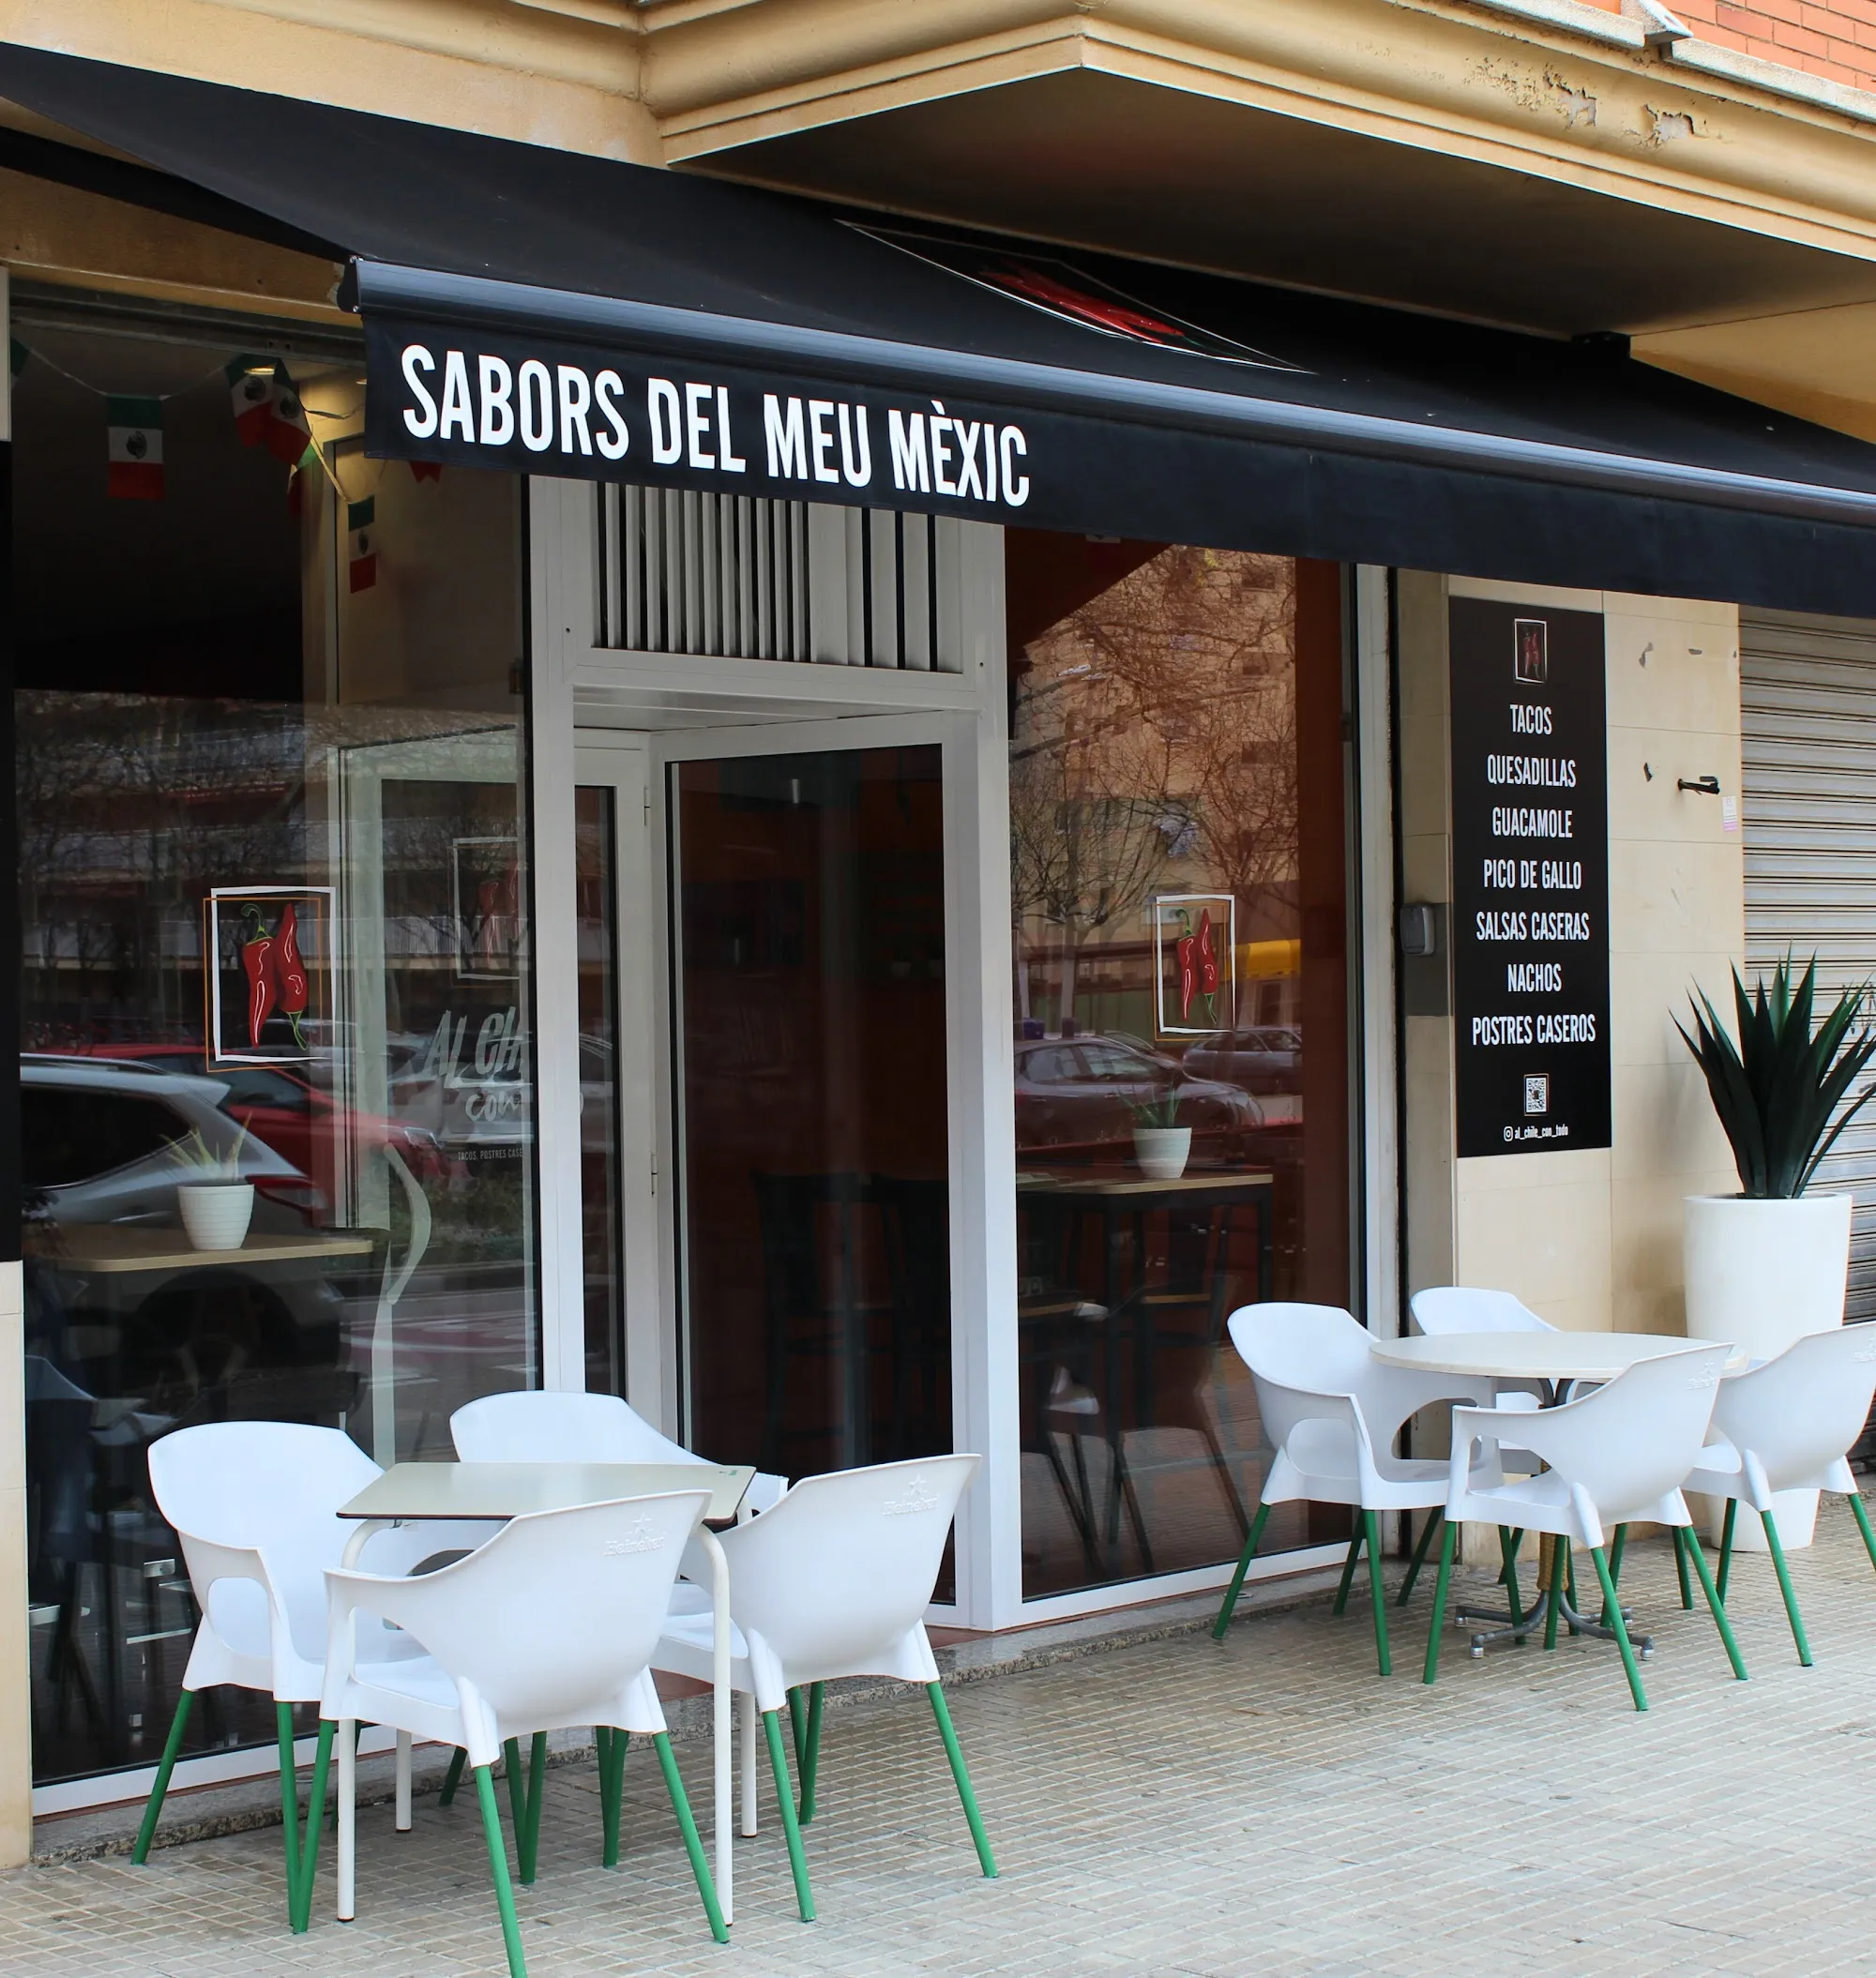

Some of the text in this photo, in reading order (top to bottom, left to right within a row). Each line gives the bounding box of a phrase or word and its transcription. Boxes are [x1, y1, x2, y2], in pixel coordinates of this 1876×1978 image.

[401, 344, 1031, 507] SABORS DEL MEU MÈXIC
[1509, 703, 1553, 735] TACOS
[1487, 754, 1577, 788] QUESADILLAS
[1492, 806, 1573, 838] GUACAMOLE
[1483, 858, 1582, 890] PICO DE GALLO
[1475, 911, 1590, 941] SALSAS CASERAS
[1507, 962, 1563, 992] NACHOS
[1472, 1013, 1596, 1046] POSTRES CASEROS
[480, 1149, 507, 1160] POSTRES
